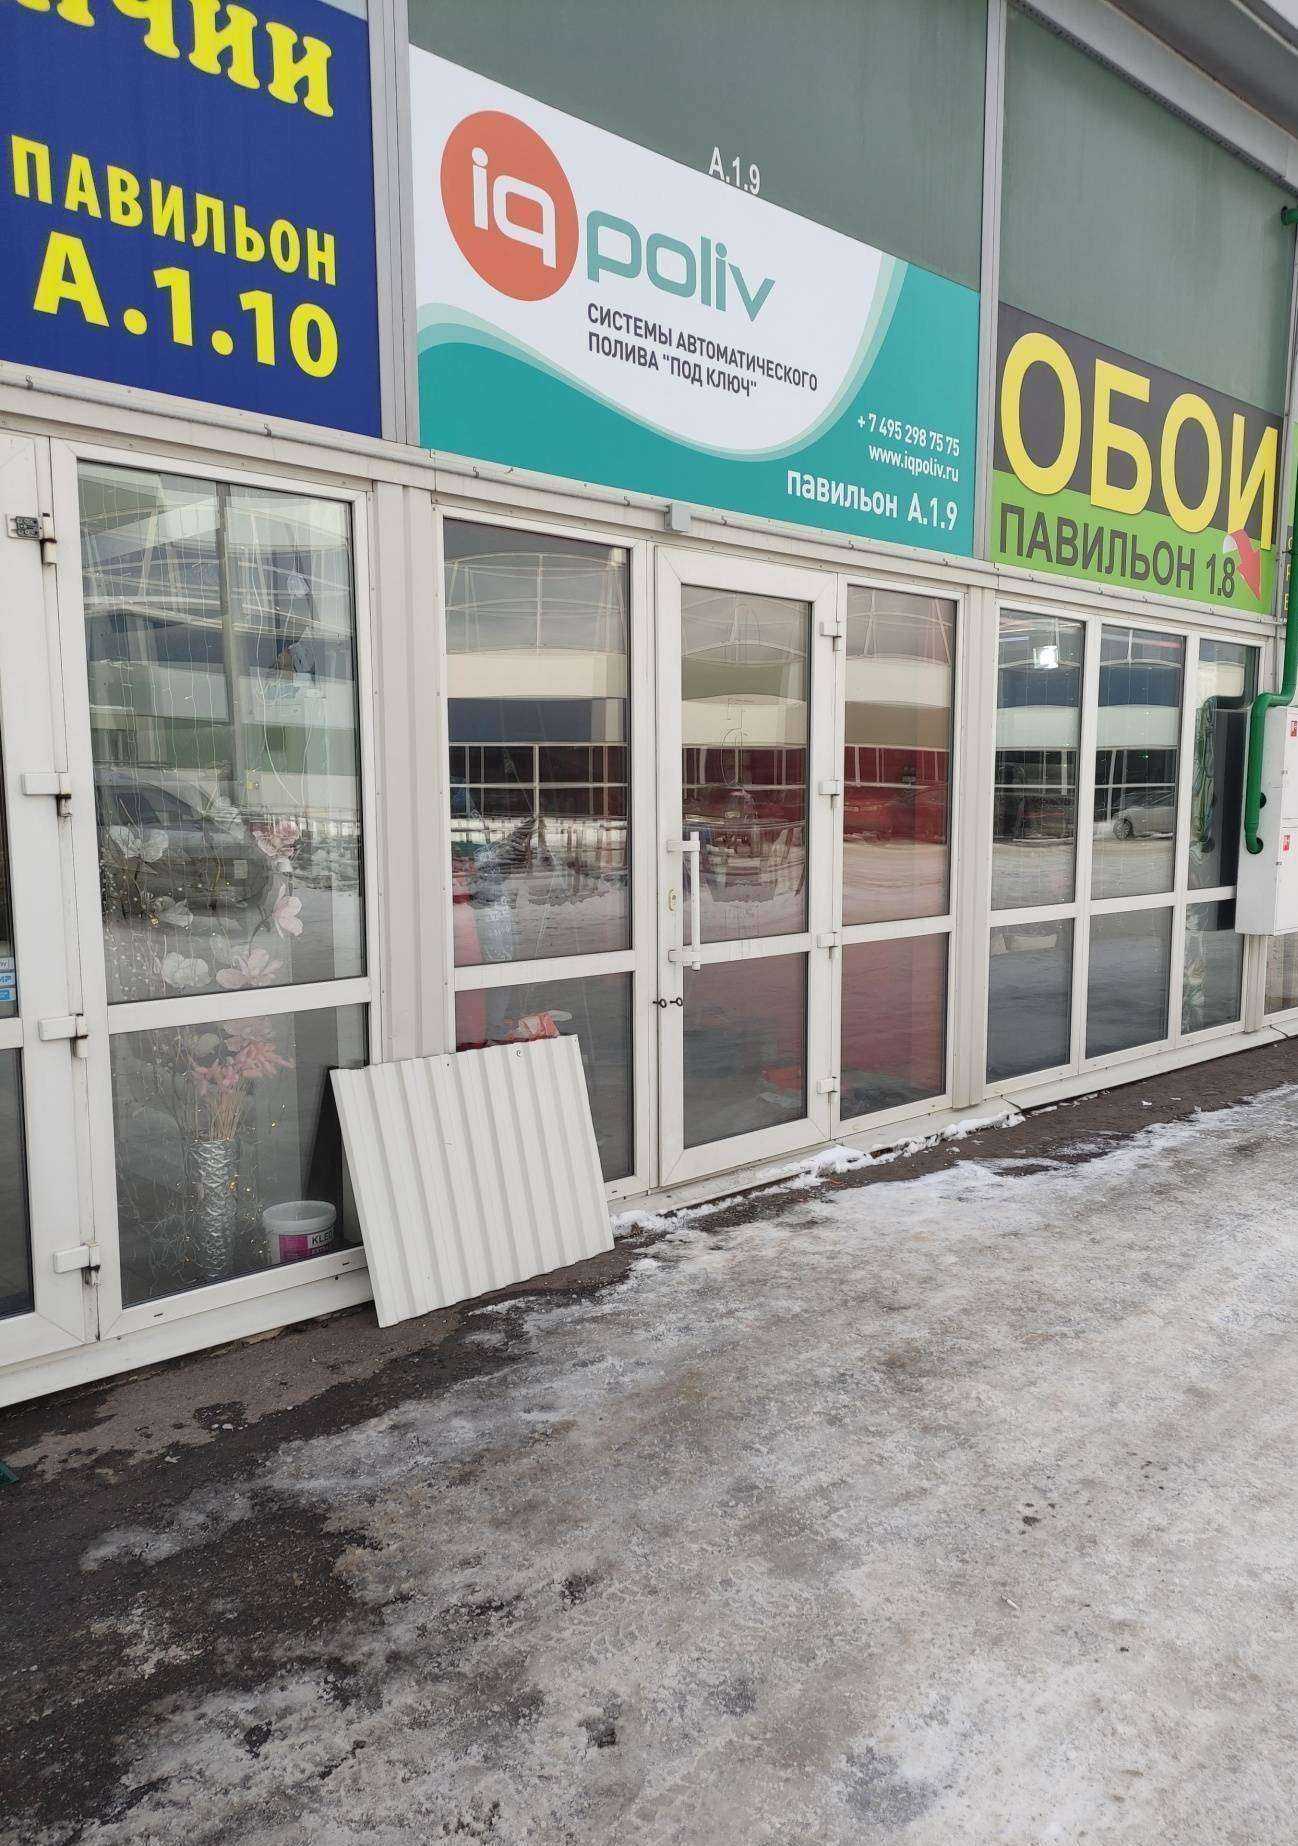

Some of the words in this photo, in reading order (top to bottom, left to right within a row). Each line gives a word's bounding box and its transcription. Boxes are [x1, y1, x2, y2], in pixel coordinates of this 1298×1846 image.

[708, 146, 760, 195] А.1.9
[11, 134, 337, 286] ПАВИЛЬОН
[33, 231, 339, 378] А.1.10
[587, 302, 673, 347] СИСТЕМЫ
[676, 331, 818, 392] АВТОМАТИЧЕСКОГО
[588, 331, 660, 371] ПОЛИВА
[662, 353, 703, 388] "ПОД
[706, 366, 758, 397] КЛЮЧ"
[869, 445, 959, 482] www.iqpoliv.ru
[880, 417, 902, 441] 495
[904, 424, 927, 448] 298
[929, 430, 944, 452] 75
[945, 436, 960, 458] 75
[1000, 332, 1279, 551] ОБОИ
[787, 470, 898, 518] павильон
[907, 491, 959, 532] А.1.9
[1000, 502, 1196, 591] ПАВИЛЬОН
[1206, 552, 1236, 599] 1.8
